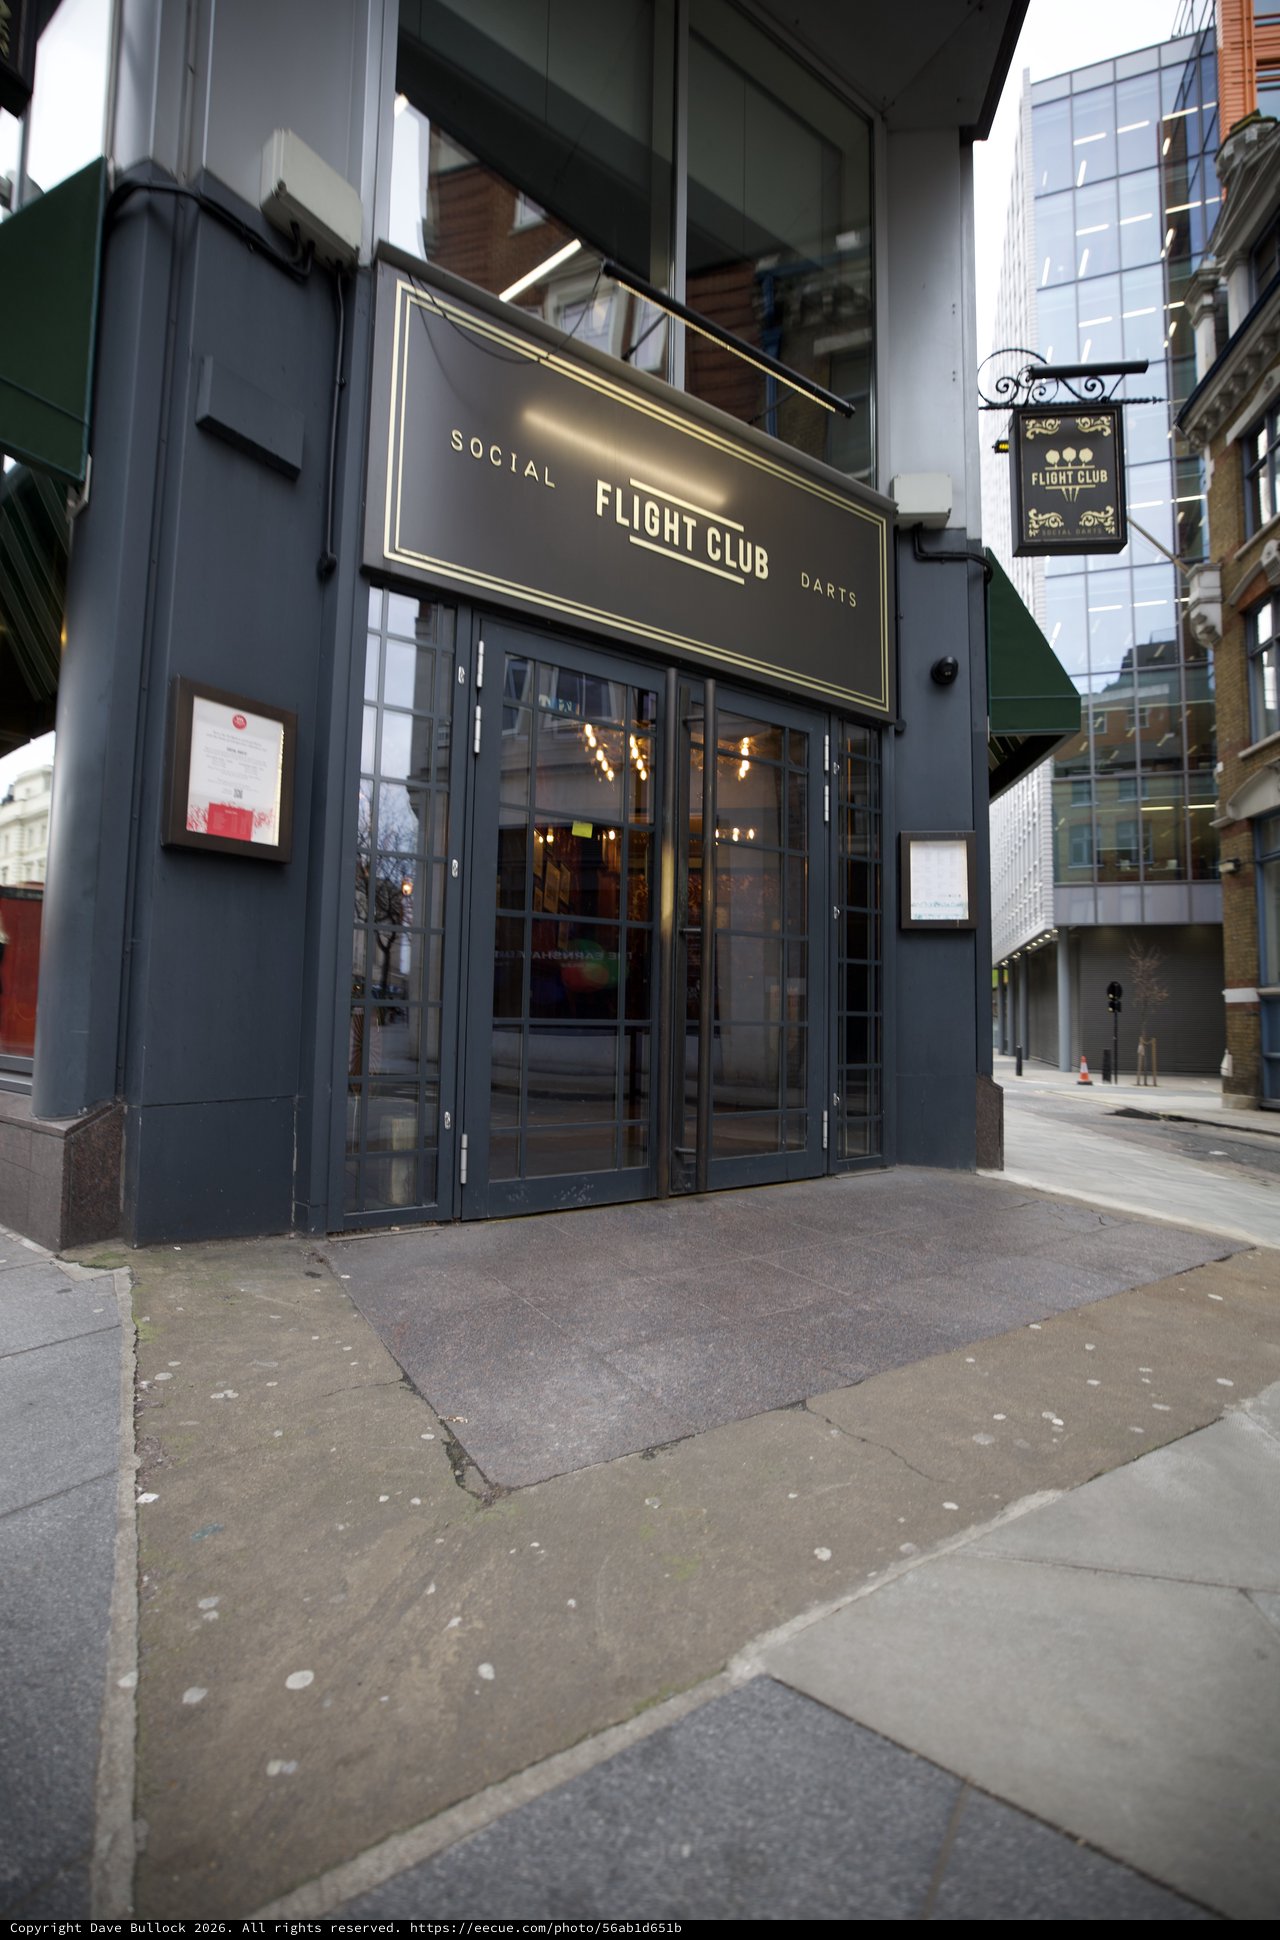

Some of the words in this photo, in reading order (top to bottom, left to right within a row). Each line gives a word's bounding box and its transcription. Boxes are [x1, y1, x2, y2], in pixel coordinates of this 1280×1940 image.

[450, 428, 556, 489] SOCIAL
[1031, 470, 1074, 486] FLIGHT
[1077, 469, 1108, 484] CLUB
[595, 478, 699, 552] FLIGHT
[706, 526, 770, 580] CLUB
[1042, 528, 1071, 537] SOCIAL
[801, 571, 858, 608] DARTS
